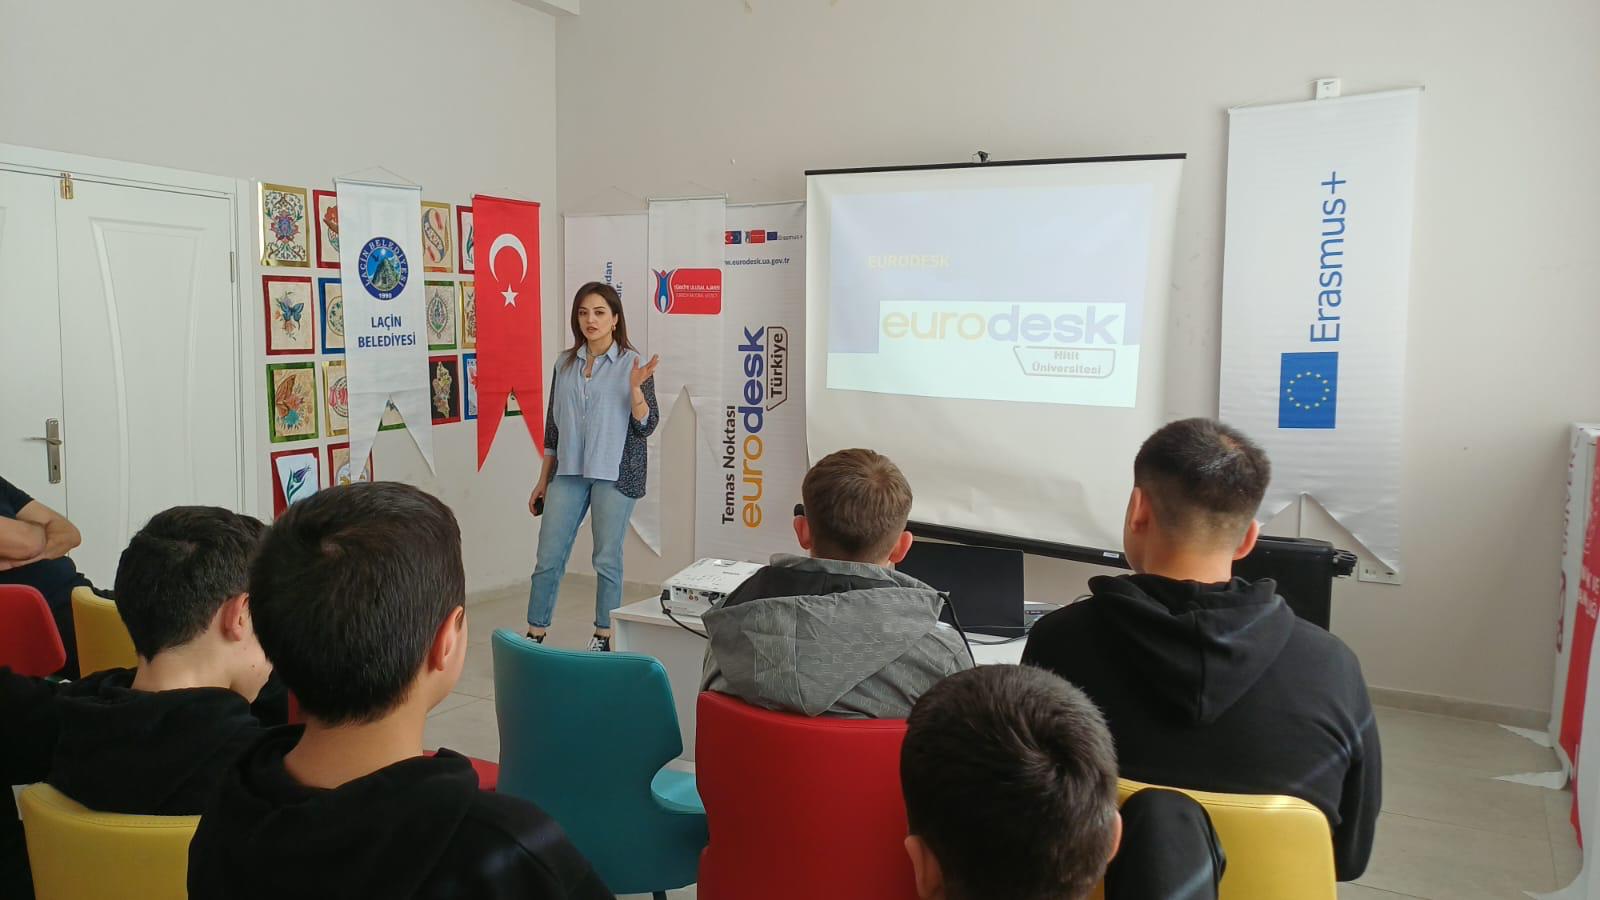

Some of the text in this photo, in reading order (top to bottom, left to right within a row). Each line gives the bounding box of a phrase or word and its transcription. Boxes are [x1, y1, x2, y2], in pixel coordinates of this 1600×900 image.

[724, 256, 790, 266] w.eurodesk.ua.gov.tr
[868, 255, 950, 269] EURODESK
[1309, 171, 1346, 343] Erasmus+
[371, 313, 402, 331] LAÇİN
[881, 304, 1120, 345] eurodesk
[358, 332, 416, 348] BELEDİYESİ
[1053, 350, 1080, 361] Hitit
[770, 333, 786, 398] Türkiye
[1031, 360, 1101, 374] Üniversitesi
[738, 326, 764, 528] eurodesk
[722, 405, 736, 525] Temas Noktası
